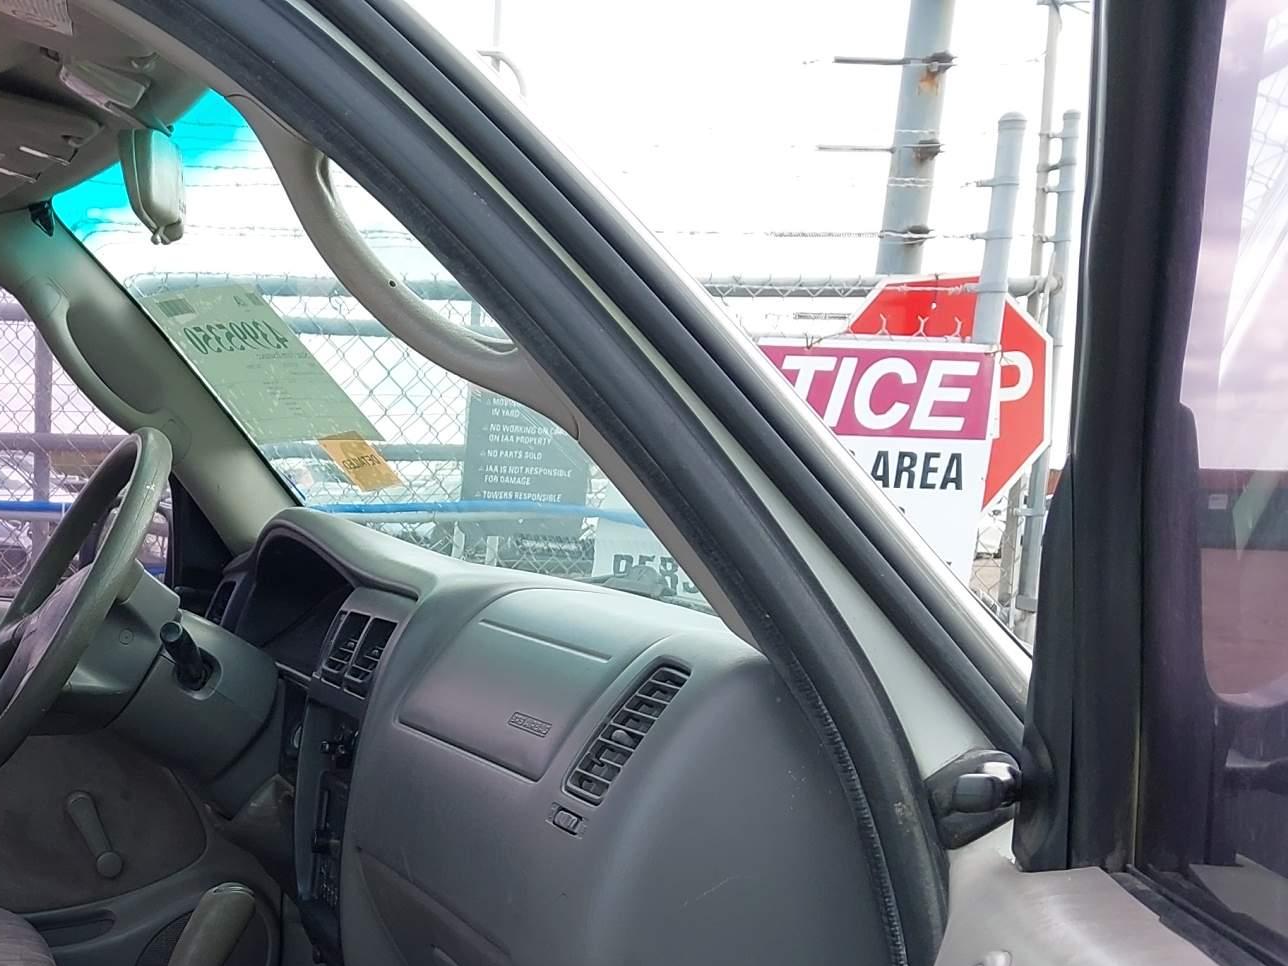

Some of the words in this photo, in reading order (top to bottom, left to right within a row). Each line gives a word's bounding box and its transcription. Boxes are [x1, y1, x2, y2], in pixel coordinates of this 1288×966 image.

[487, 449, 498, 457] NO
[499, 450, 522, 459] PARTS
[523, 451, 542, 460] SOLD
[485, 464, 499, 474] IAA
[524, 466, 573, 478] RESPONSIBLE
[871, 450, 963, 491] AREA
[499, 475, 531, 486] DAMAGE
[514, 491, 562, 503] RESPONSIBLE
